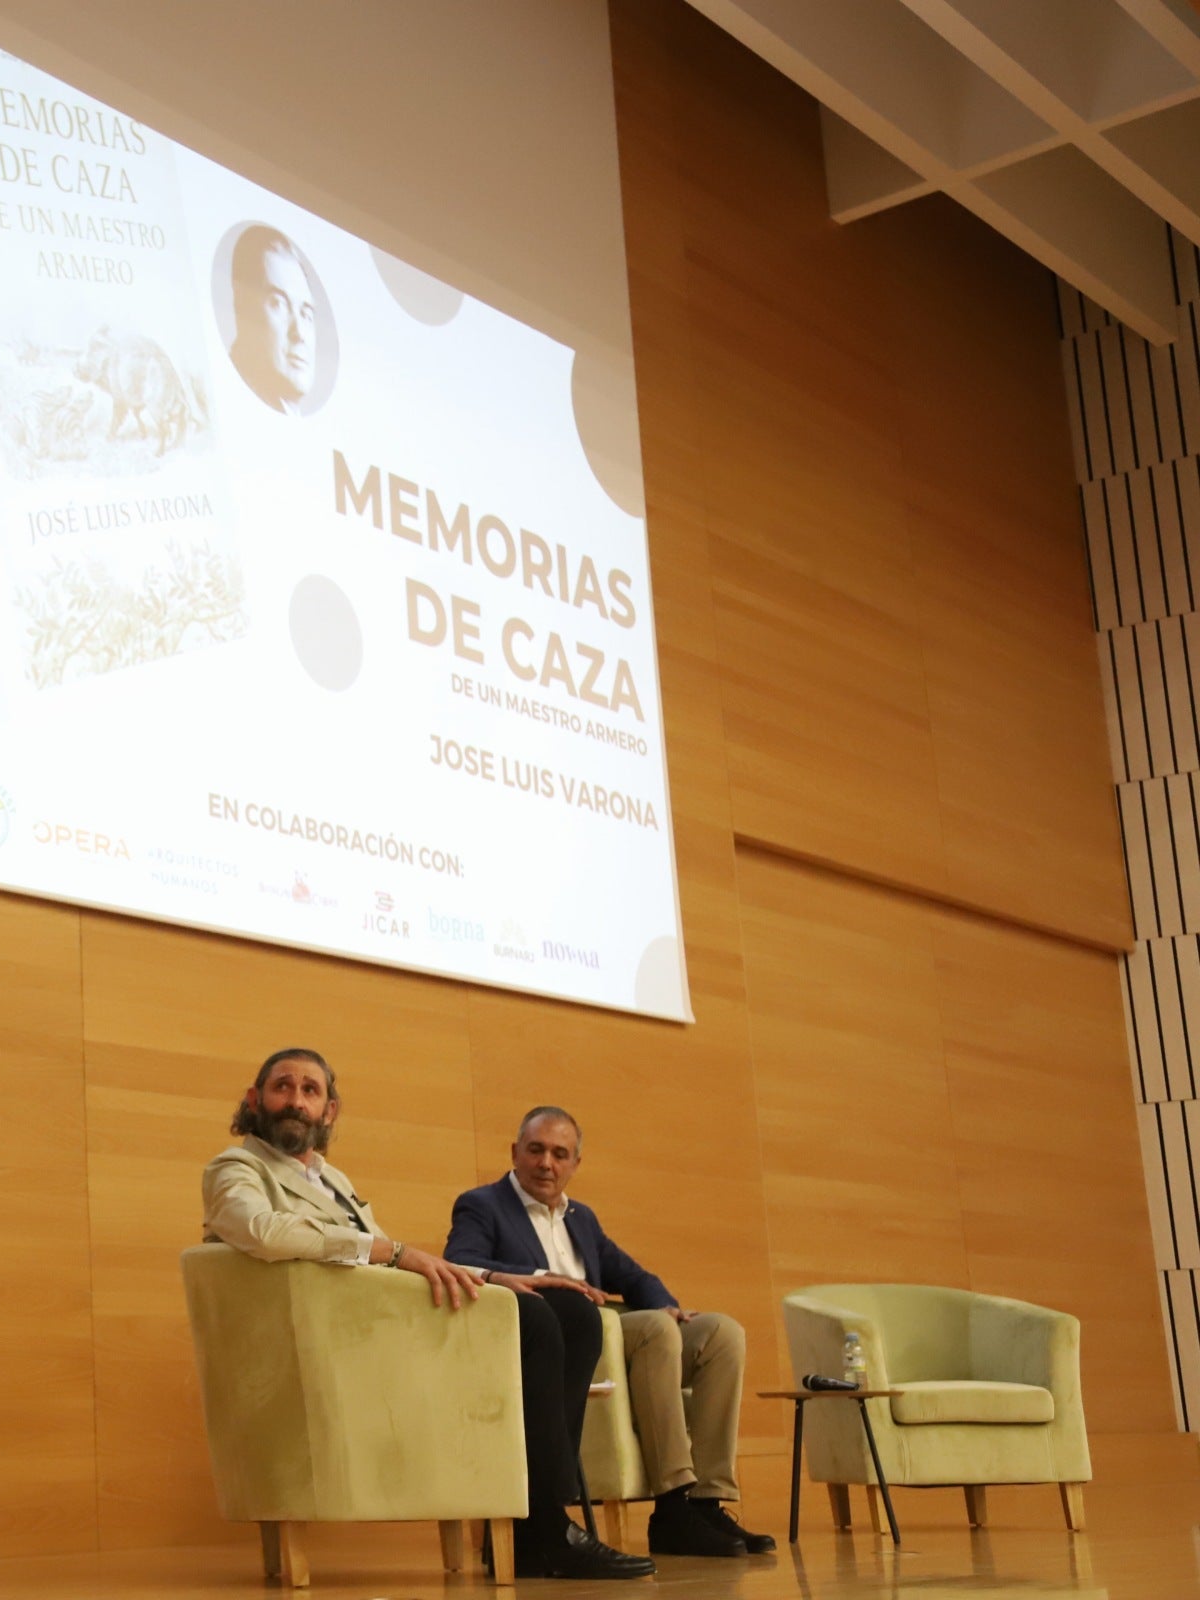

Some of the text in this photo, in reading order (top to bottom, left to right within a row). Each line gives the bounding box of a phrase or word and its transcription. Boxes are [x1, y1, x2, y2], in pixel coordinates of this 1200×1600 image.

[52, 154, 138, 203] CAZA
[17, 204, 55, 235] UN
[62, 211, 165, 250] MAESTRO
[38, 249, 133, 285] ARMERO
[28, 493, 213, 545] JOSÉ LUIS VARONA
[333, 448, 636, 629] MEMORIAS
[405, 576, 646, 723] DE CAZA
[452, 673, 648, 756] DE UN MAESTRO ARMERO
[430, 734, 659, 831] JOSE LUIS VARONA
[32, 821, 131, 861] OPERA
[208, 793, 465, 878] EN COLABORACIÓN CON:
[362, 912, 410, 939] JICAR
